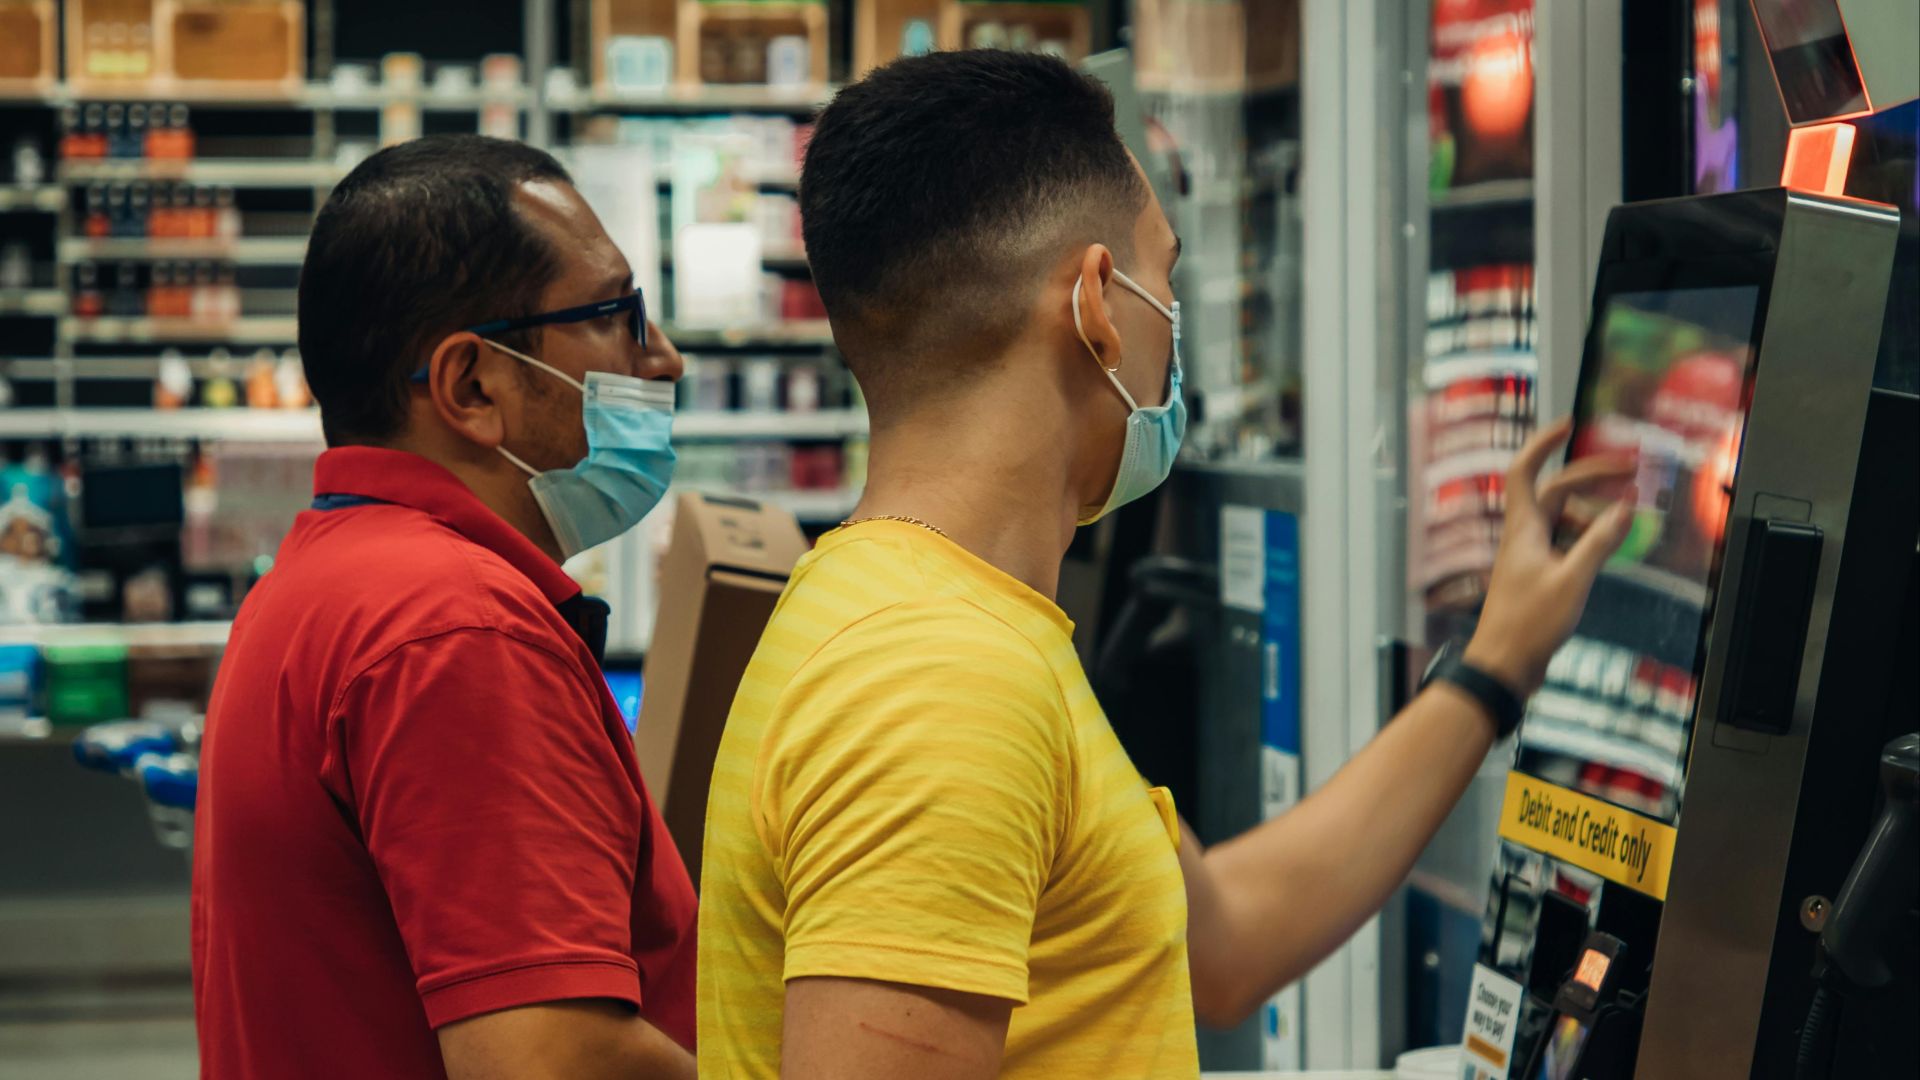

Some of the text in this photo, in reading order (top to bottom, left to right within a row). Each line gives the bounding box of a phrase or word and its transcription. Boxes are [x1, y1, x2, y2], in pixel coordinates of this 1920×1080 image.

[1519, 788, 1652, 883] Debit and Credit only
